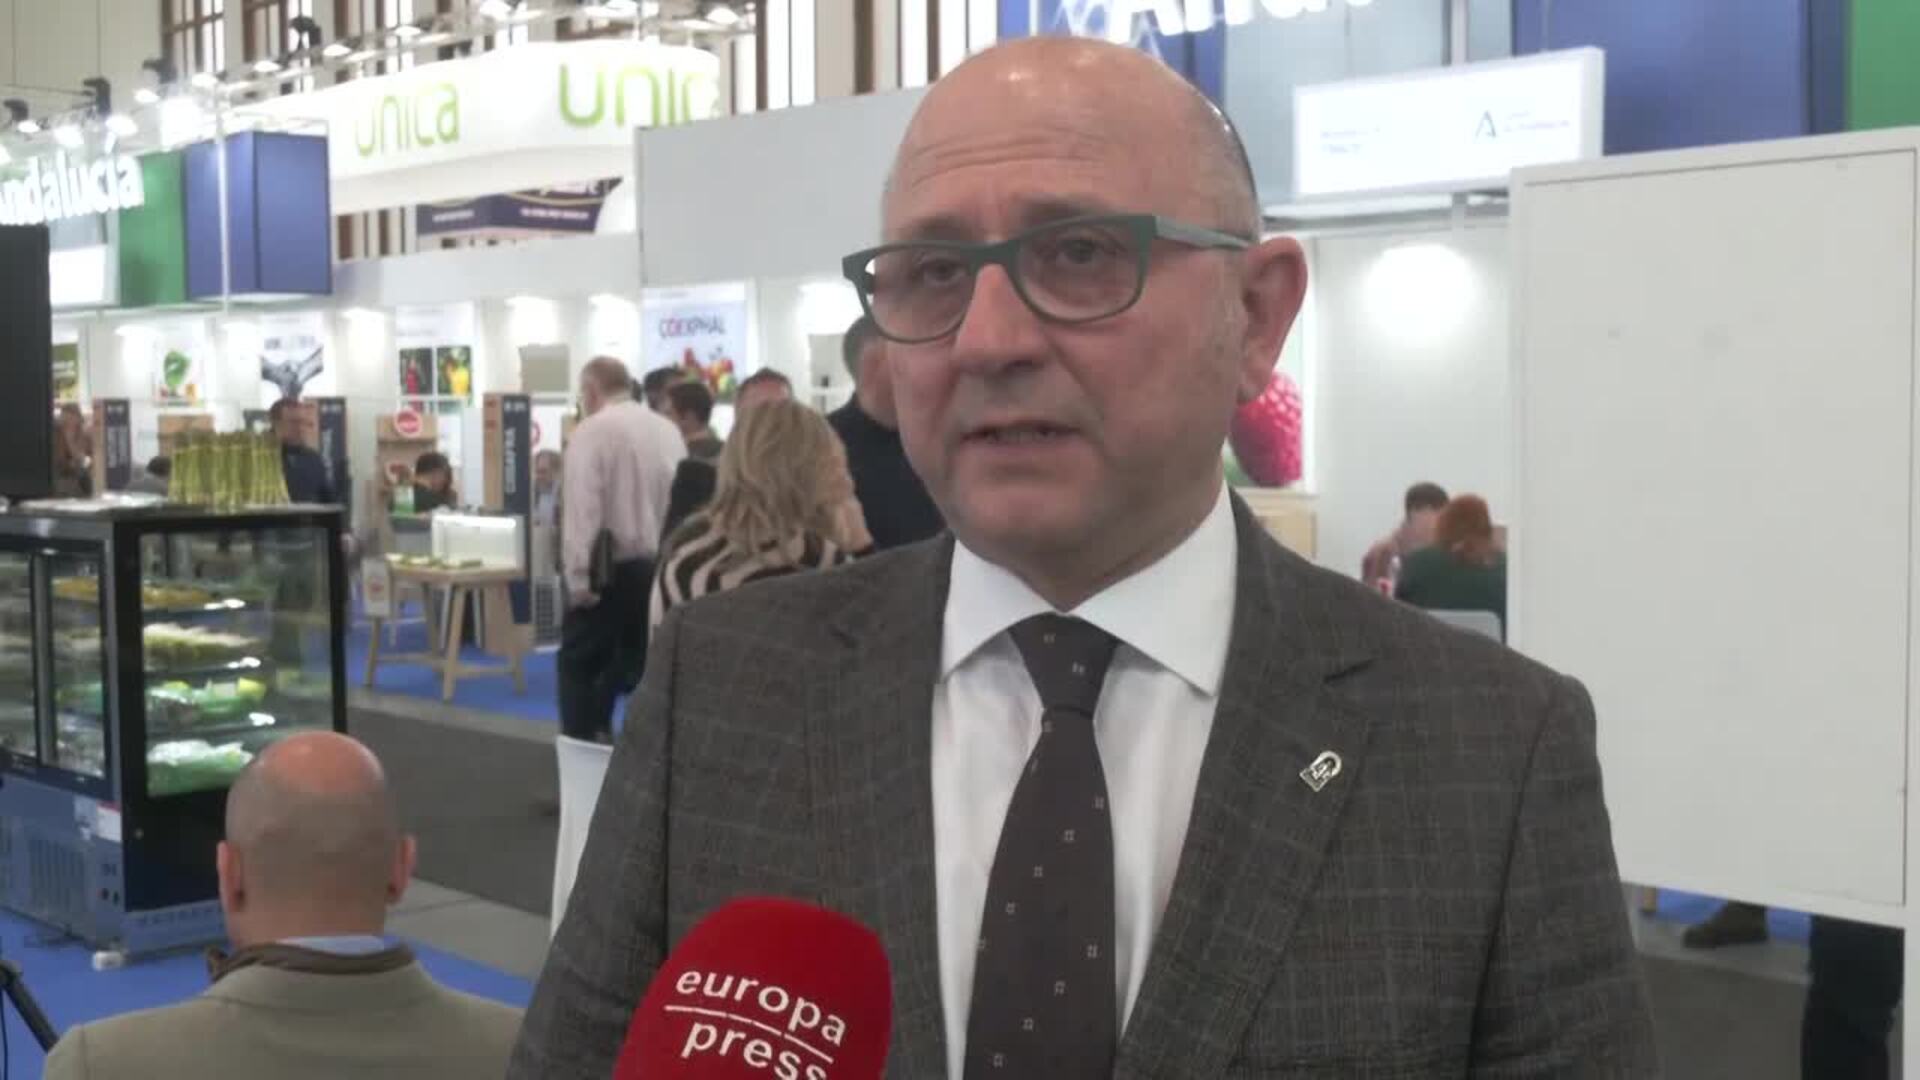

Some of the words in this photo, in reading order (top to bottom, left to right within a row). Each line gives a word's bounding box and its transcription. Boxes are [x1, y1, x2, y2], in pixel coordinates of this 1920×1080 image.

[355, 82, 460, 156] unica
[0, 132, 144, 226] ndalucía
[675, 971, 846, 1048] europa
